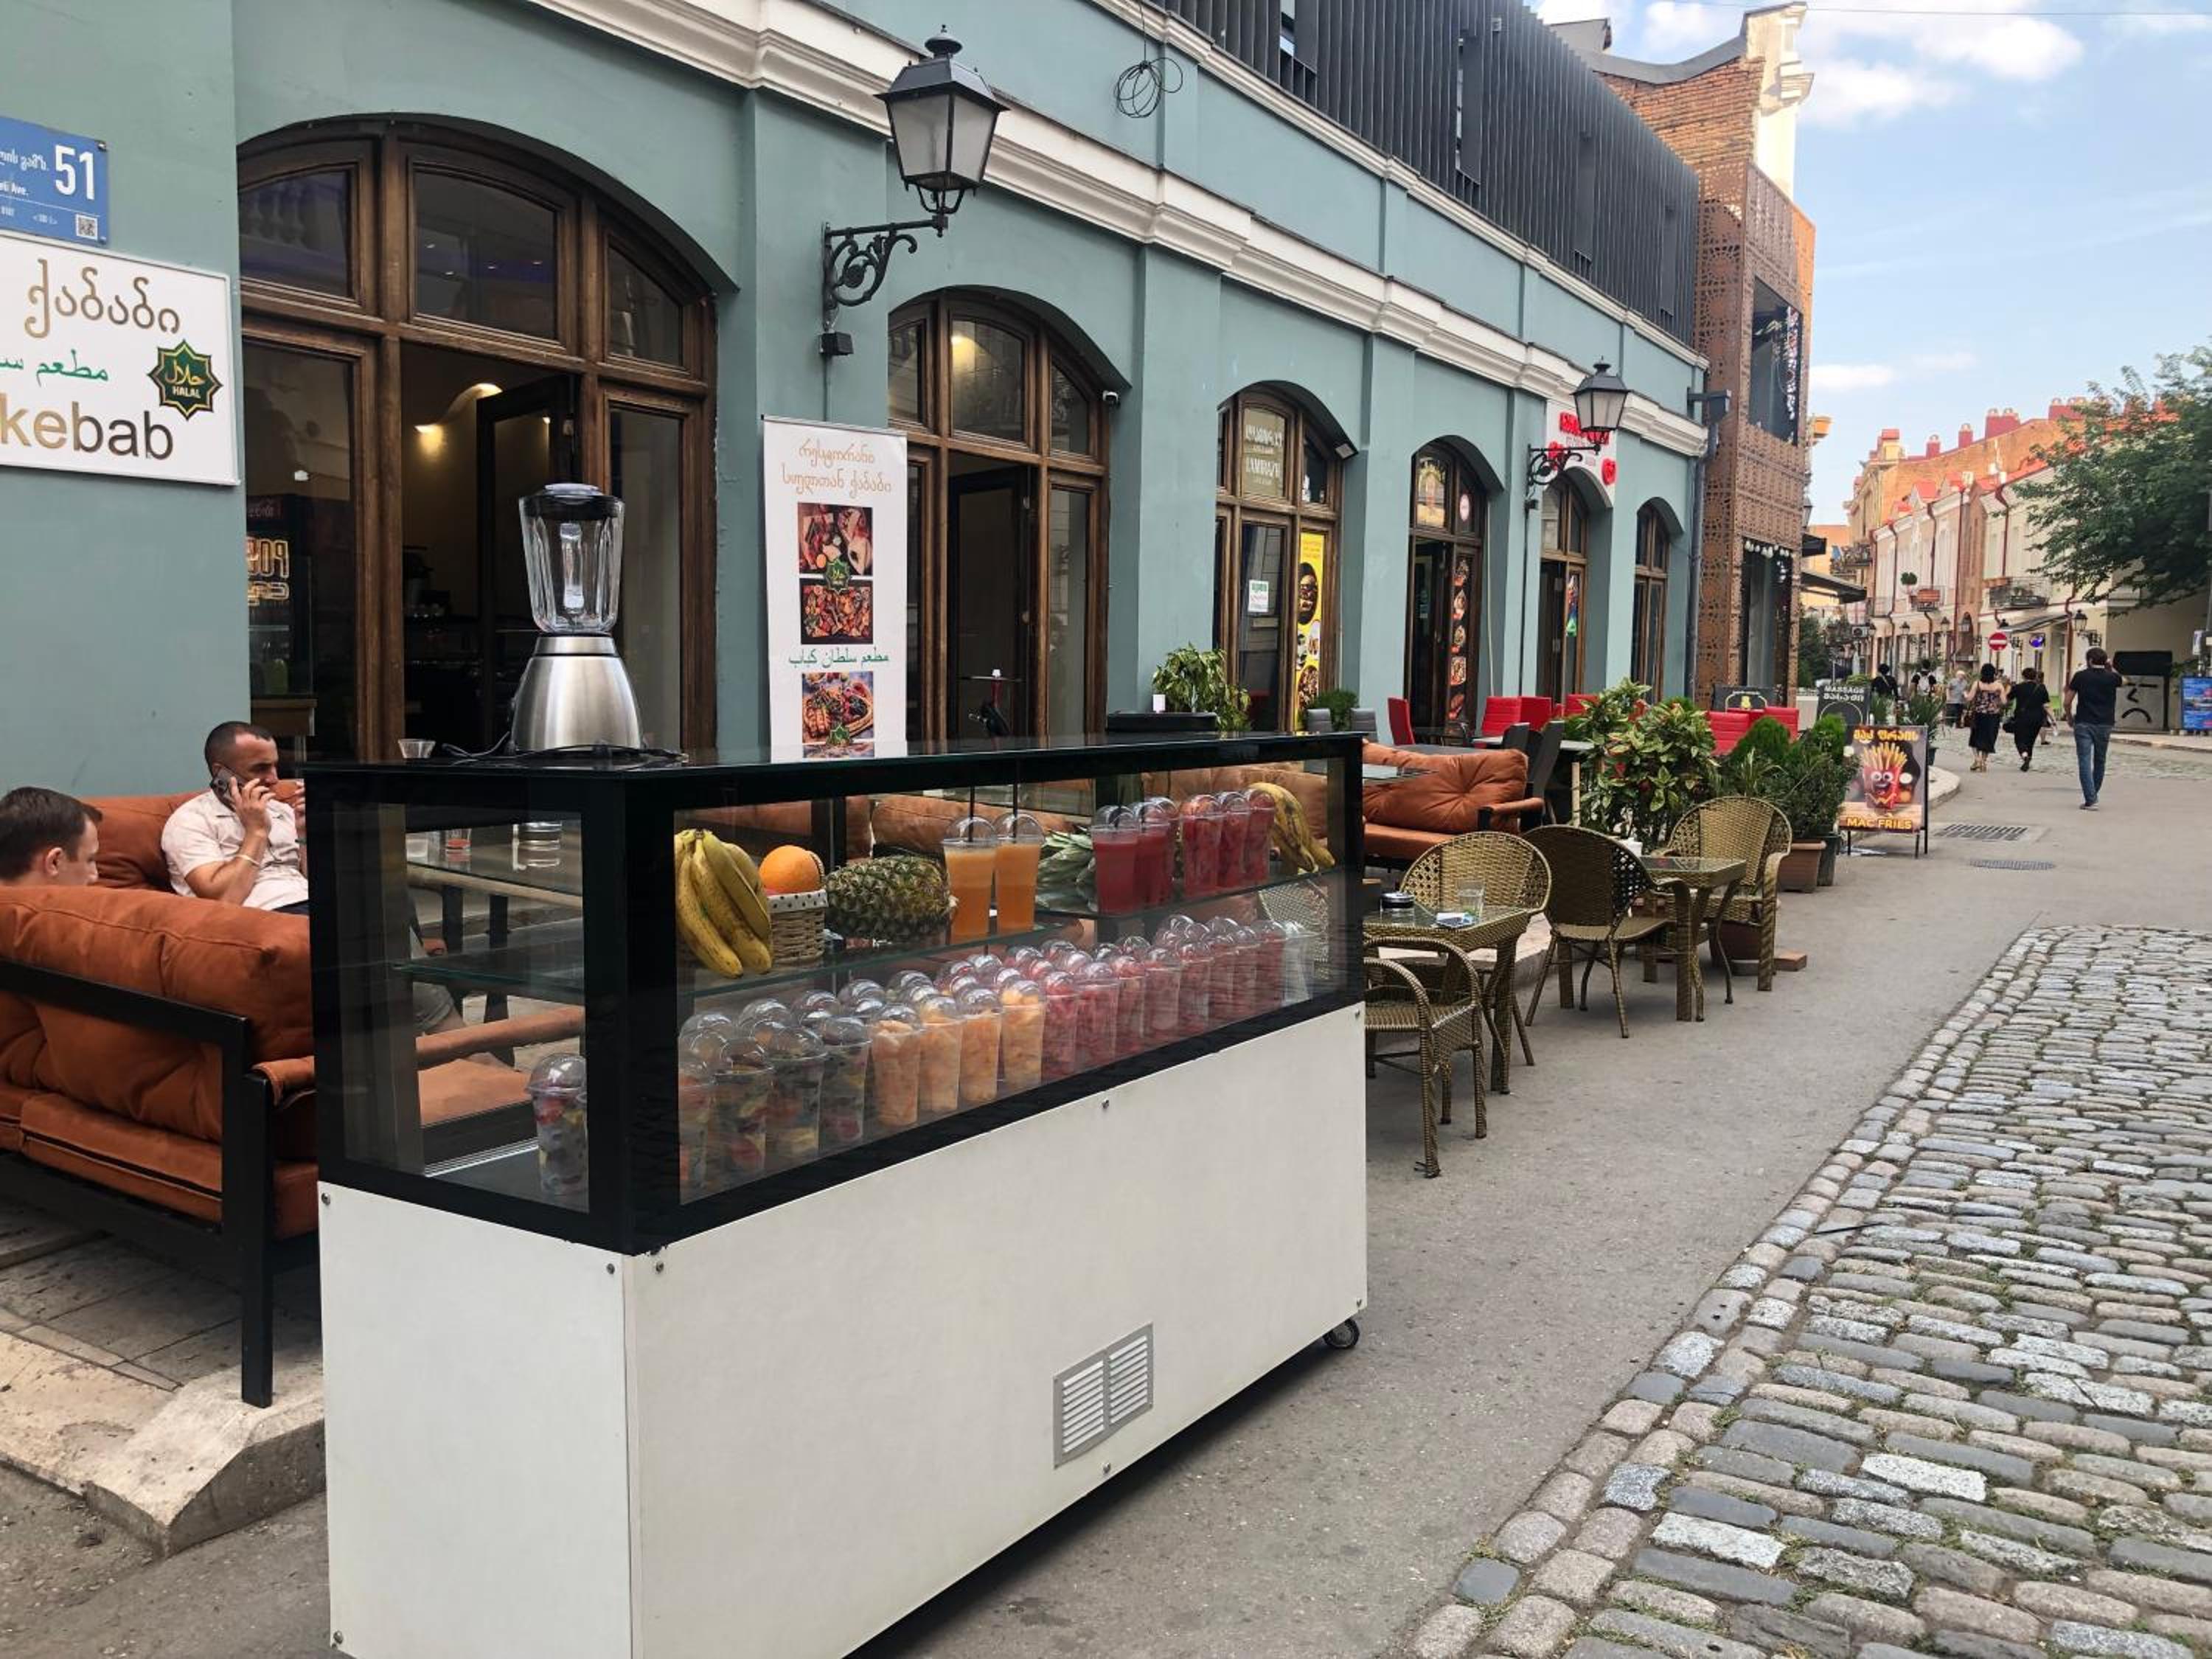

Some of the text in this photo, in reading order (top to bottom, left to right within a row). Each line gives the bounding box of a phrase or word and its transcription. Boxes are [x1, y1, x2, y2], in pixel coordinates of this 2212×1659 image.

[55, 145, 94, 200] 51
[24, 260, 180, 338] ქაბაბი
[36, 349, 108, 387] مطعم
[164, 360, 205, 385] حلال
[172, 386, 201, 399] HALAL
[0, 392, 173, 460] kebab
[822, 647, 858, 668] سلطان
[1824, 686, 1864, 694] MASSAGE
[1847, 817, 1874, 827] MAC
